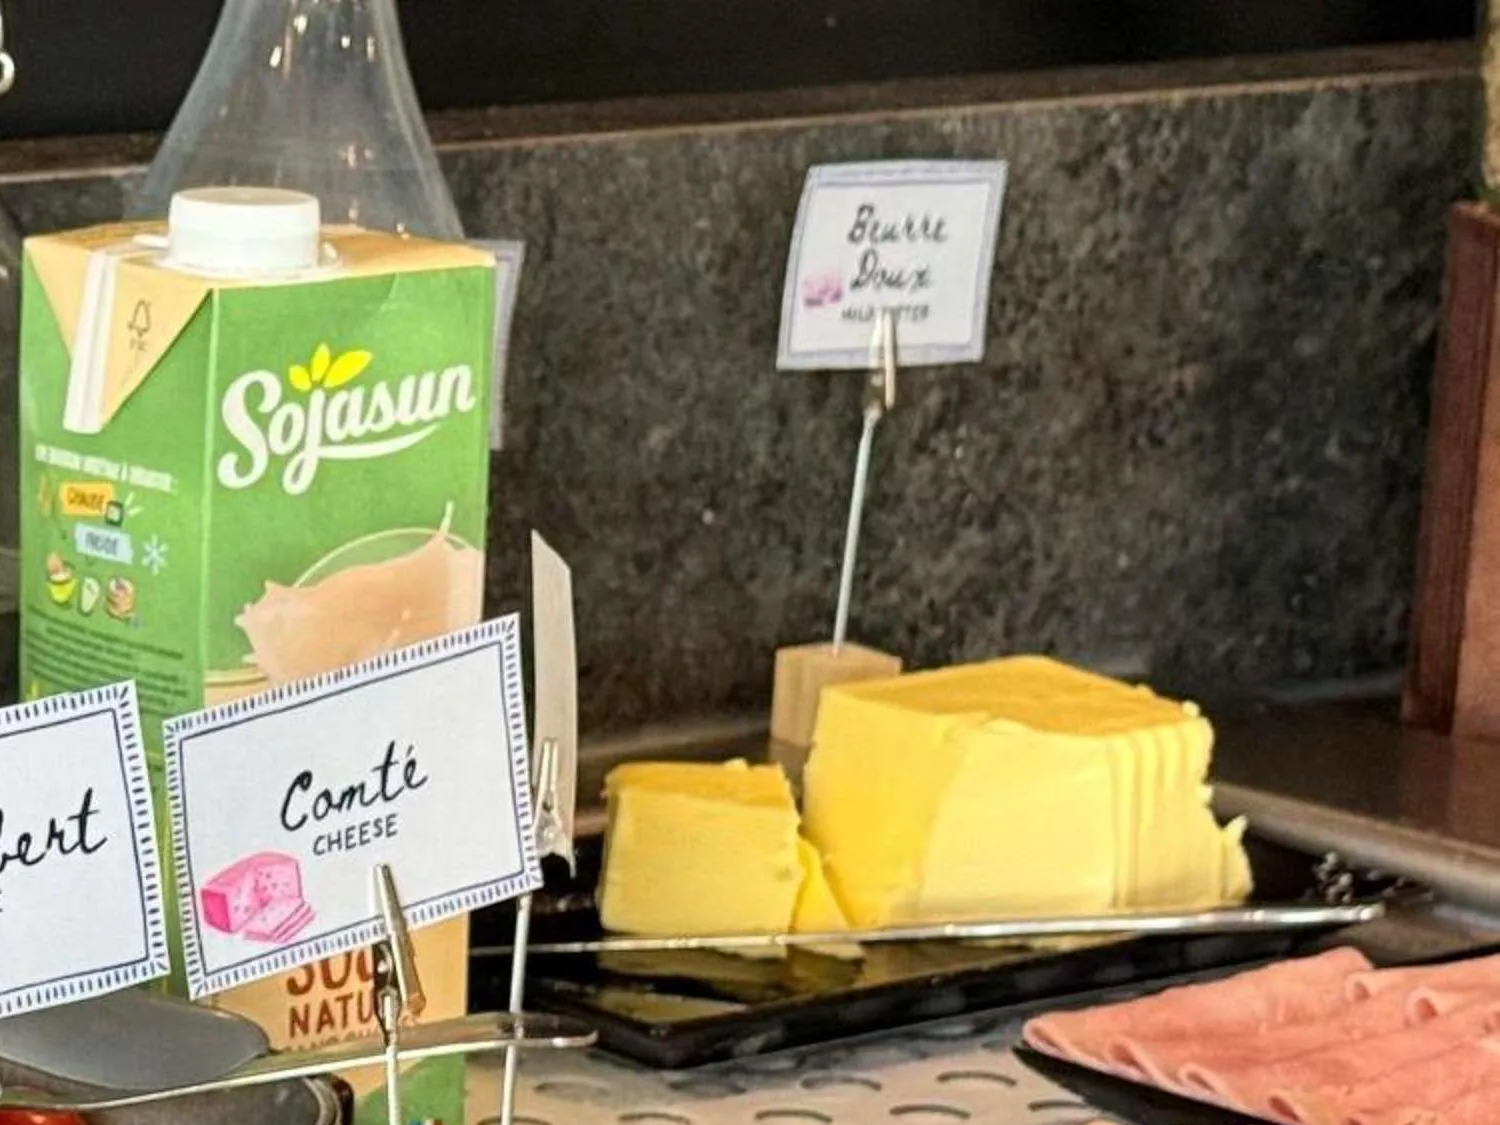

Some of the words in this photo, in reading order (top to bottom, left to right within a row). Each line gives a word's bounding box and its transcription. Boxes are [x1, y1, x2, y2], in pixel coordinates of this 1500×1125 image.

[850, 249, 931, 291] Doux
[217, 364, 476, 496] Sojasun
[279, 740, 429, 832] Comté
[311, 812, 400, 858] CHEESE
[289, 987, 374, 1039] NATU
